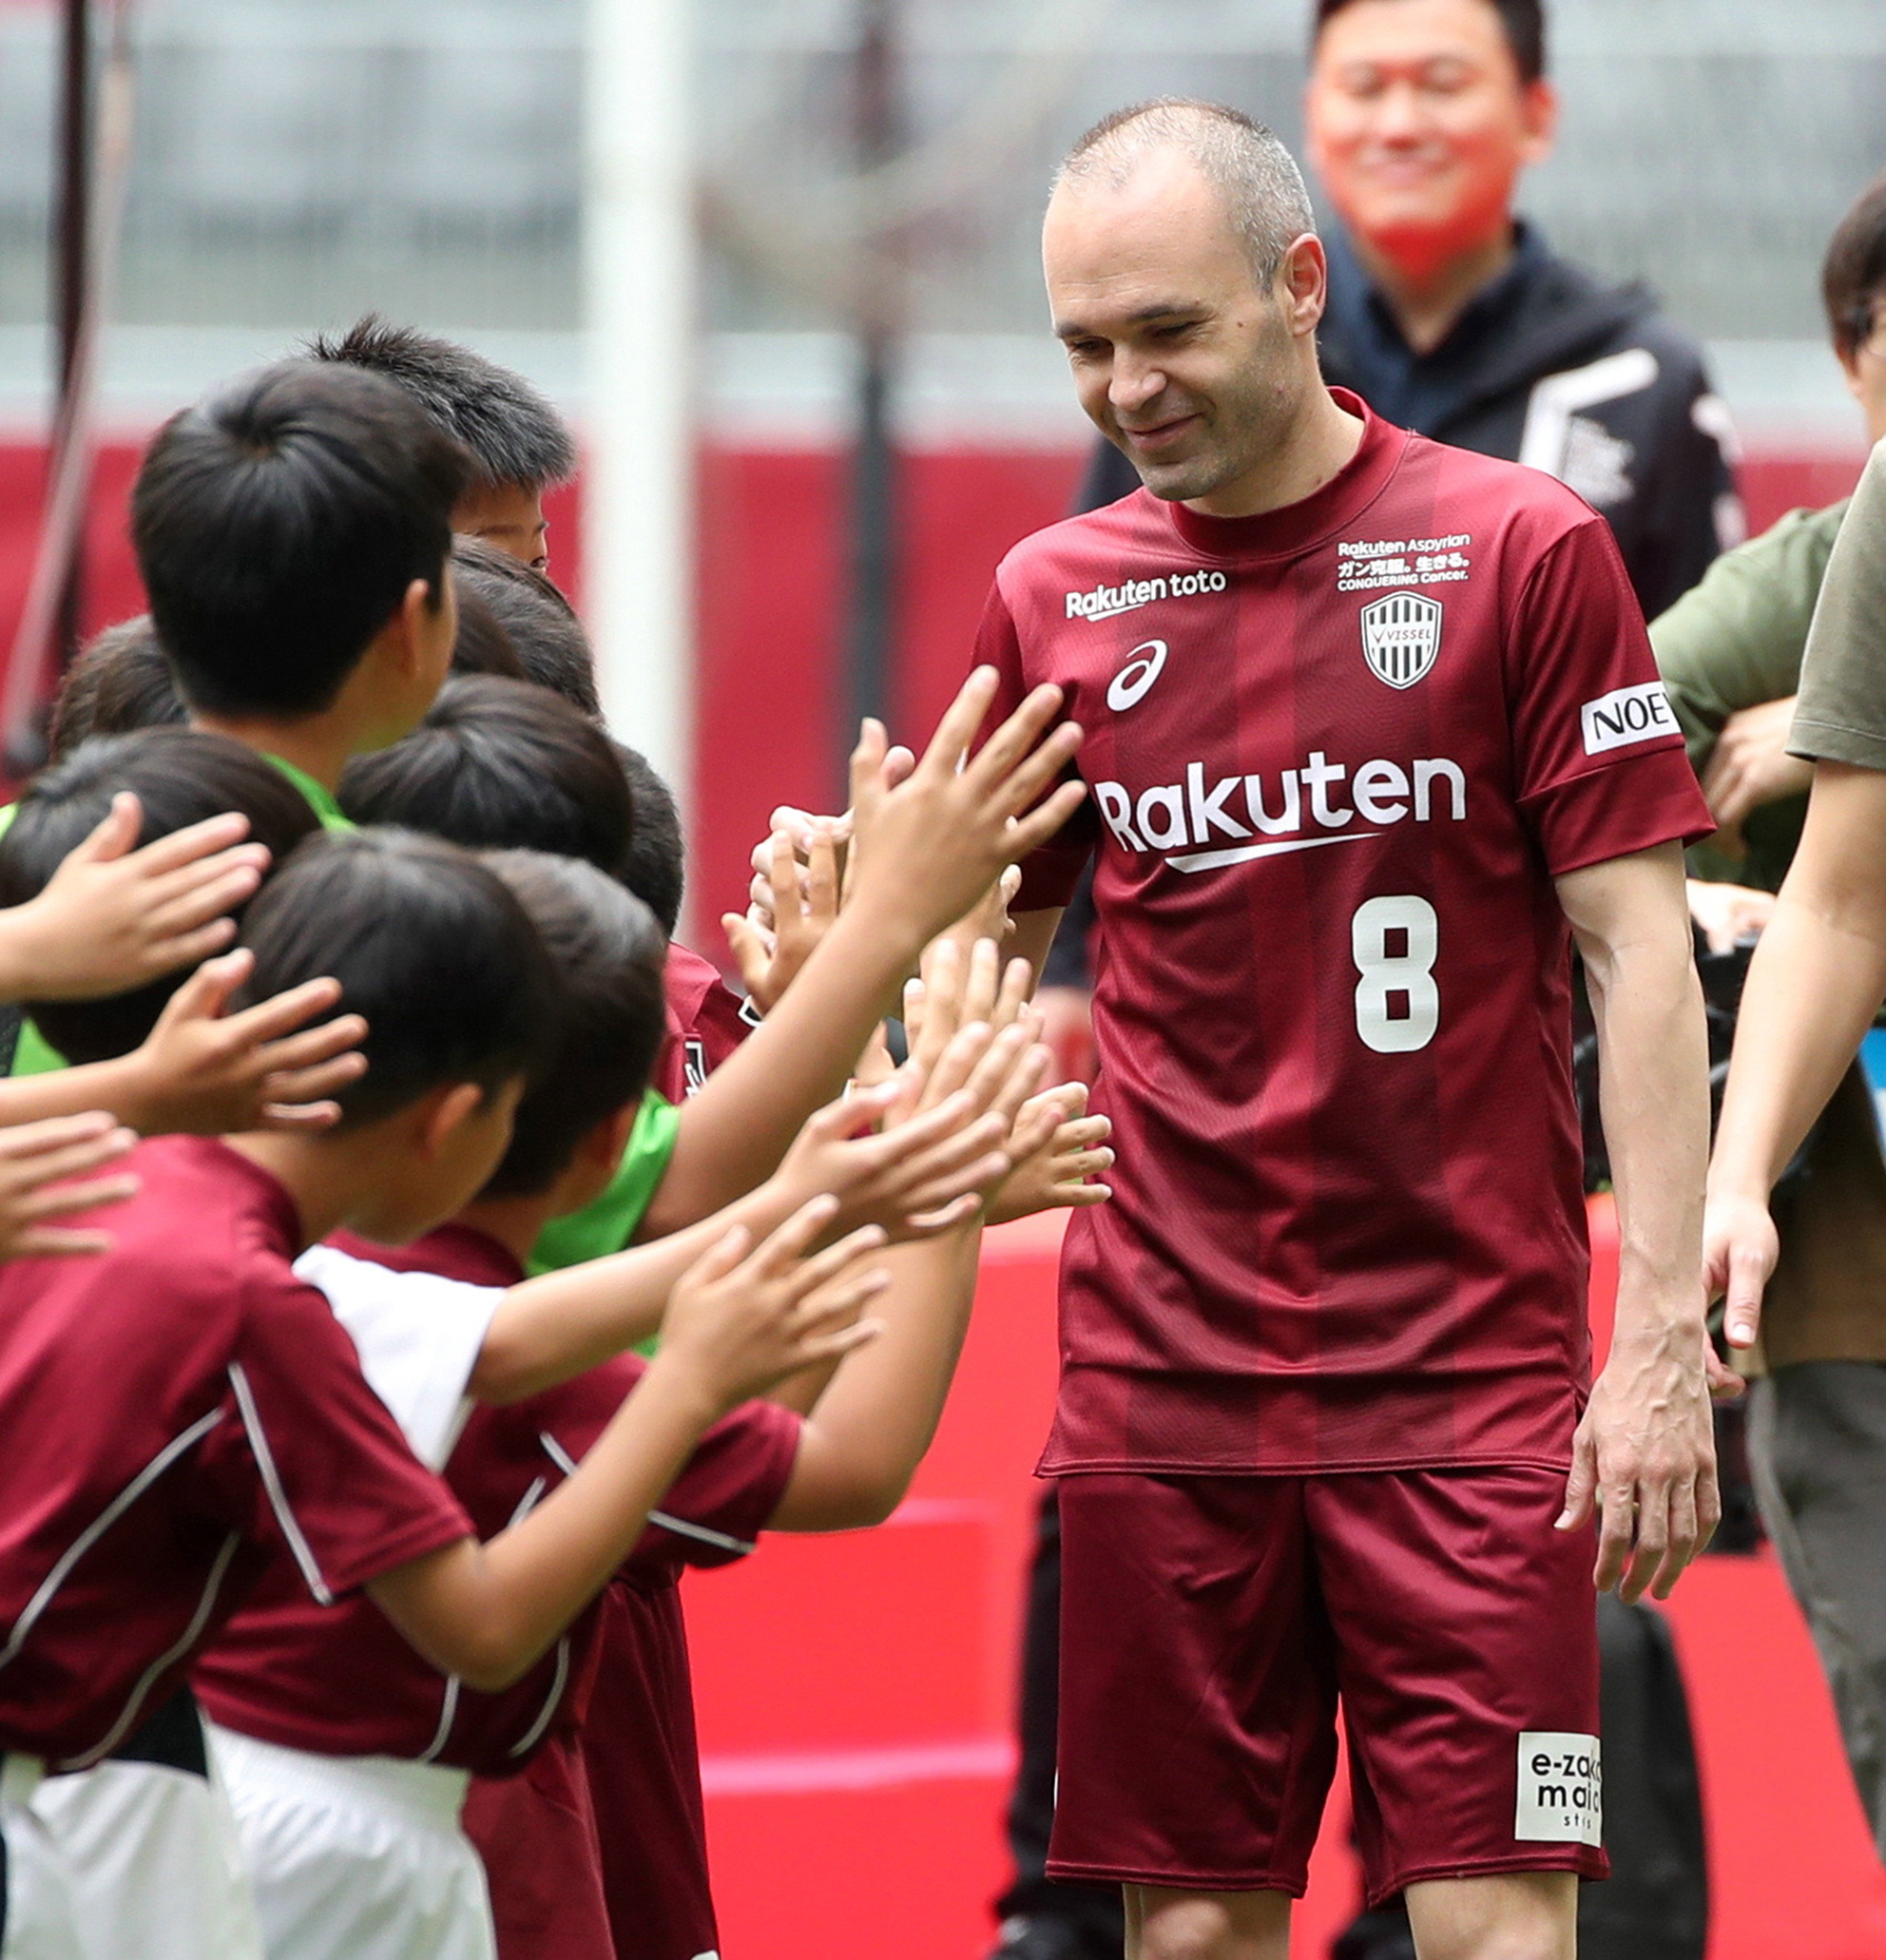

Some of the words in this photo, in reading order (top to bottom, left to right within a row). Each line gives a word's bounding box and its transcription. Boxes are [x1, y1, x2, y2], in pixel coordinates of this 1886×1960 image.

[1338, 540, 1405, 558] Rakuten
[1407, 534, 1471, 553] Aspyrian
[1066, 579, 1166, 620] Rakuten
[1169, 569, 1226, 597] toto
[1338, 573, 1418, 591] CONQUERING
[1420, 570, 1469, 584] Cancer.
[1387, 628, 1432, 641] VISSEL
[1094, 751, 1466, 853] Rakuten
[1352, 894, 1439, 1053] 8
